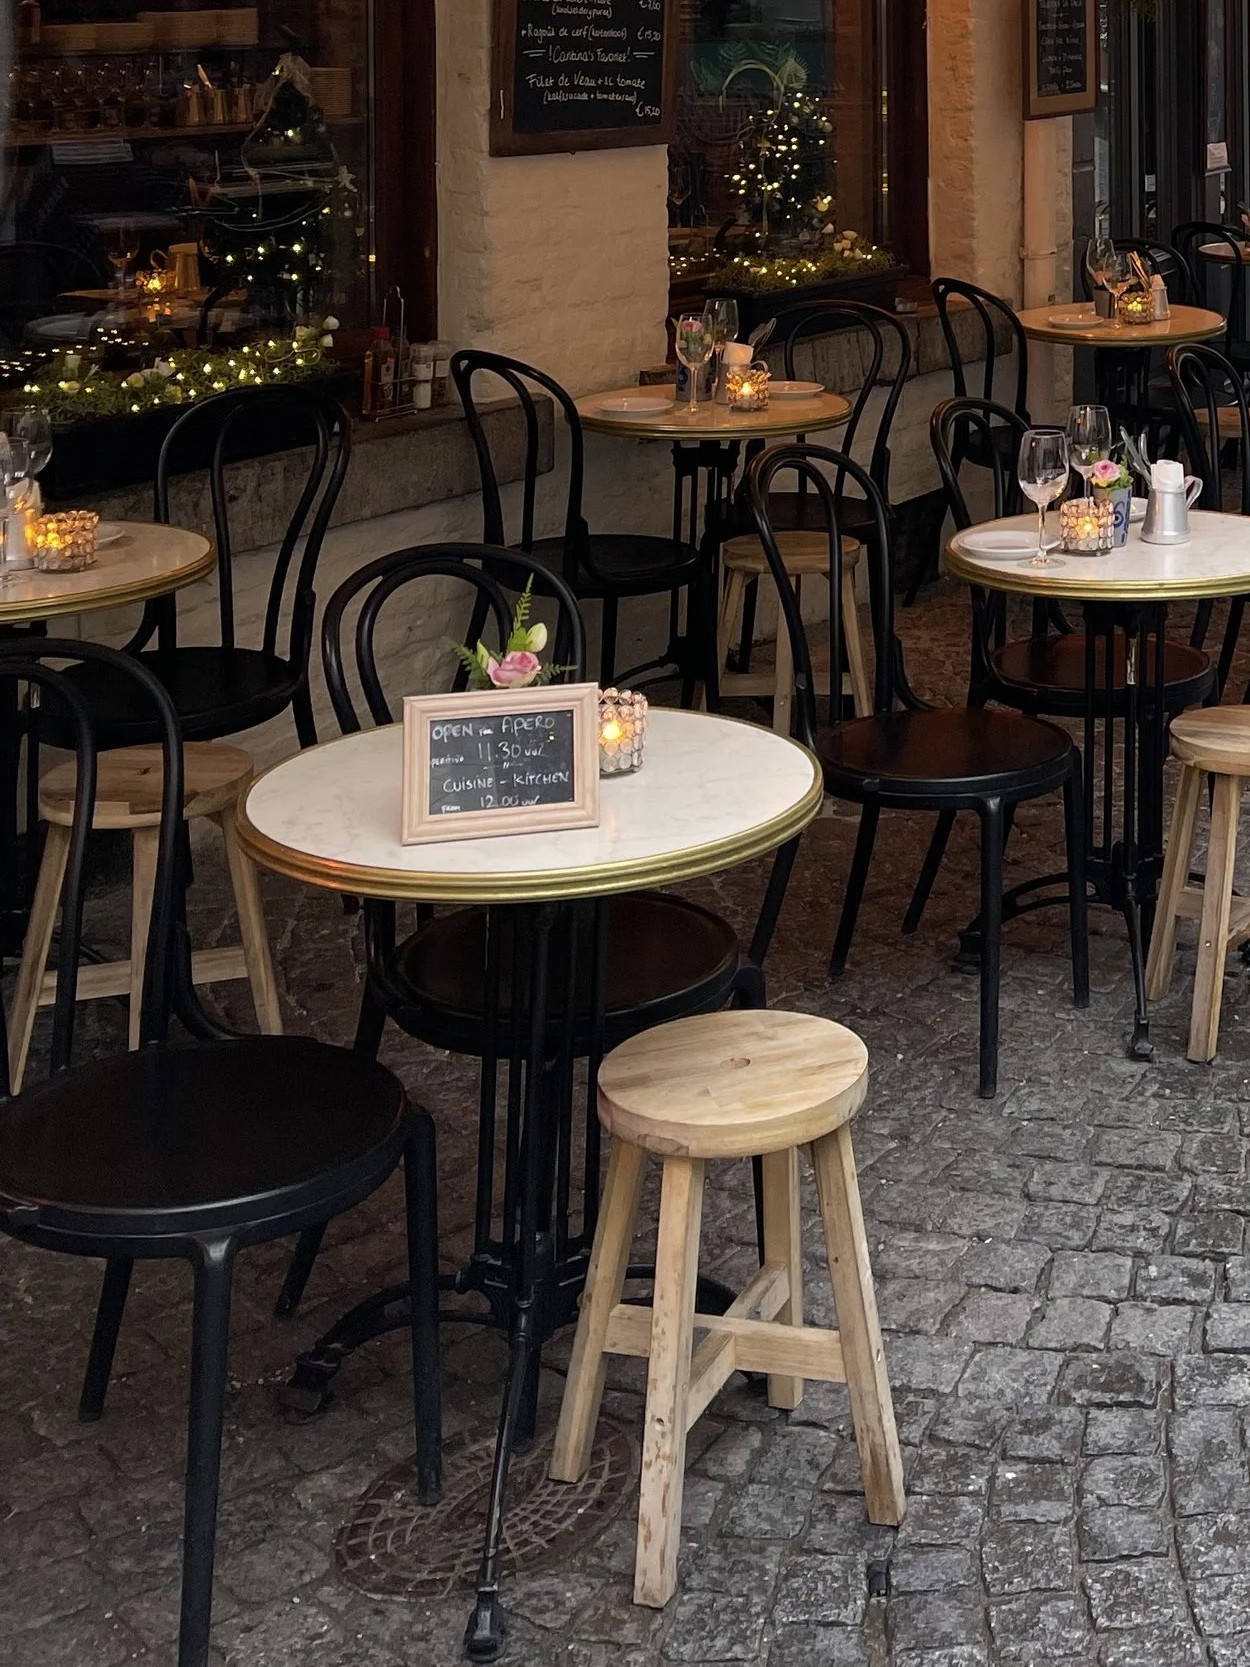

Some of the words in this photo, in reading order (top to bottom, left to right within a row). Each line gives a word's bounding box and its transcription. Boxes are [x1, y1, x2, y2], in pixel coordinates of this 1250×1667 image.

[558, 73, 570, 86] de
[616, 74, 645, 89] tomate
[432, 723, 473, 743] OPEN
[502, 715, 555, 737] APERO
[478, 741, 521, 761] 11.30
